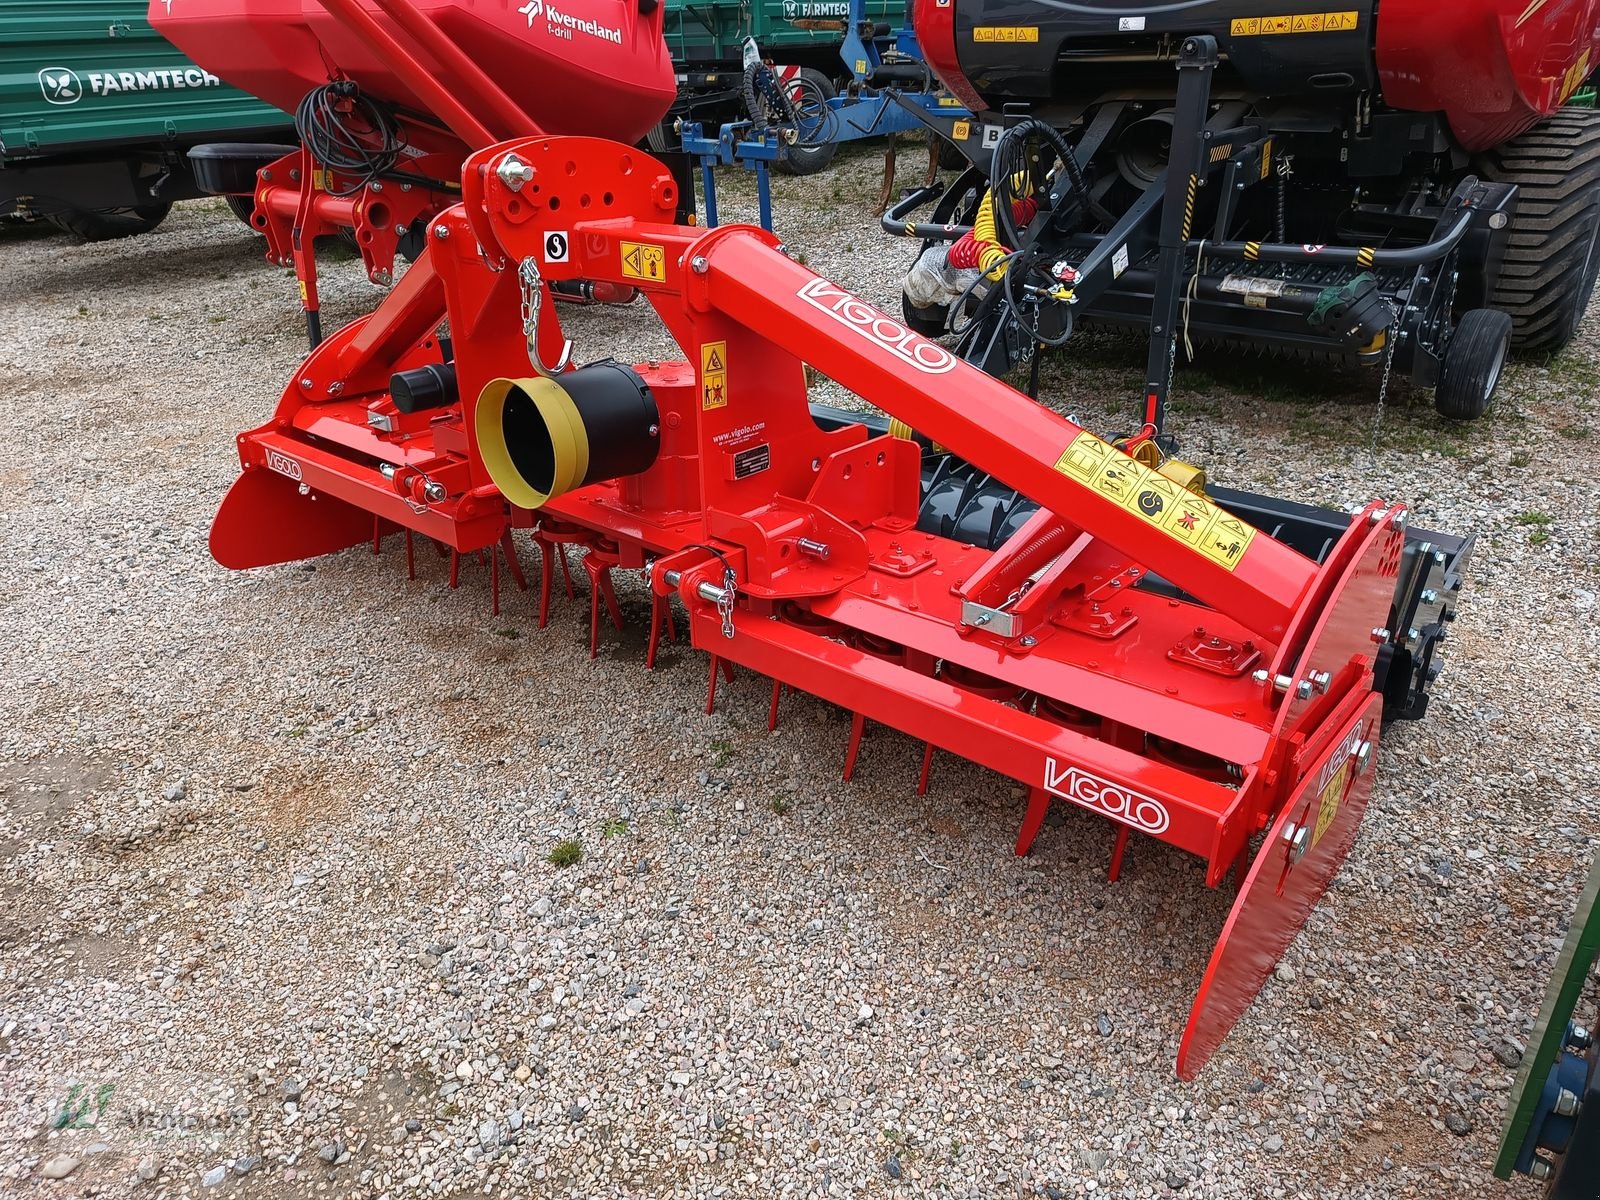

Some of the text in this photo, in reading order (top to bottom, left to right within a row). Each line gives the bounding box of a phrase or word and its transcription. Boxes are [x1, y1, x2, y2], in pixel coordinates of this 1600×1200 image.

[545, 4, 622, 44] Kverneland
[547, 23, 573, 41] f-drill
[988, 130, 999, 141] B
[796, 277, 957, 374] VIGOLO
[713, 422, 765, 443] www.vigolo.com
[265, 448, 303, 481] VIGOLO
[1043, 756, 1170, 834] VIGOLO
